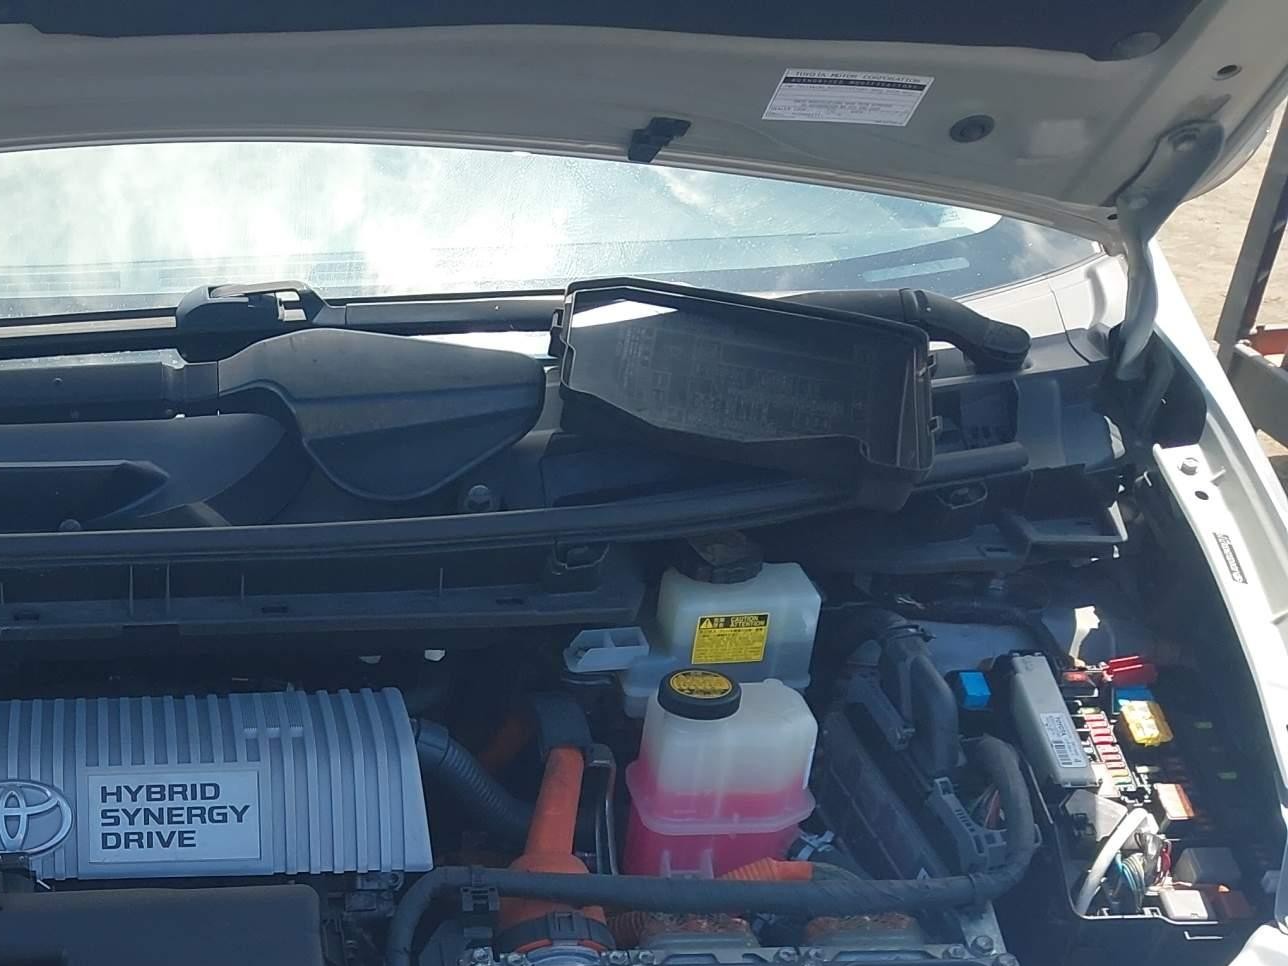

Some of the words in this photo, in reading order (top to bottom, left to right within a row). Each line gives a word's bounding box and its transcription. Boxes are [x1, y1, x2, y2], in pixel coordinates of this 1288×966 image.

[100, 782, 221, 803] HYBRID
[100, 804, 251, 827] SYNERGY
[100, 830, 197, 850] DRIVE
